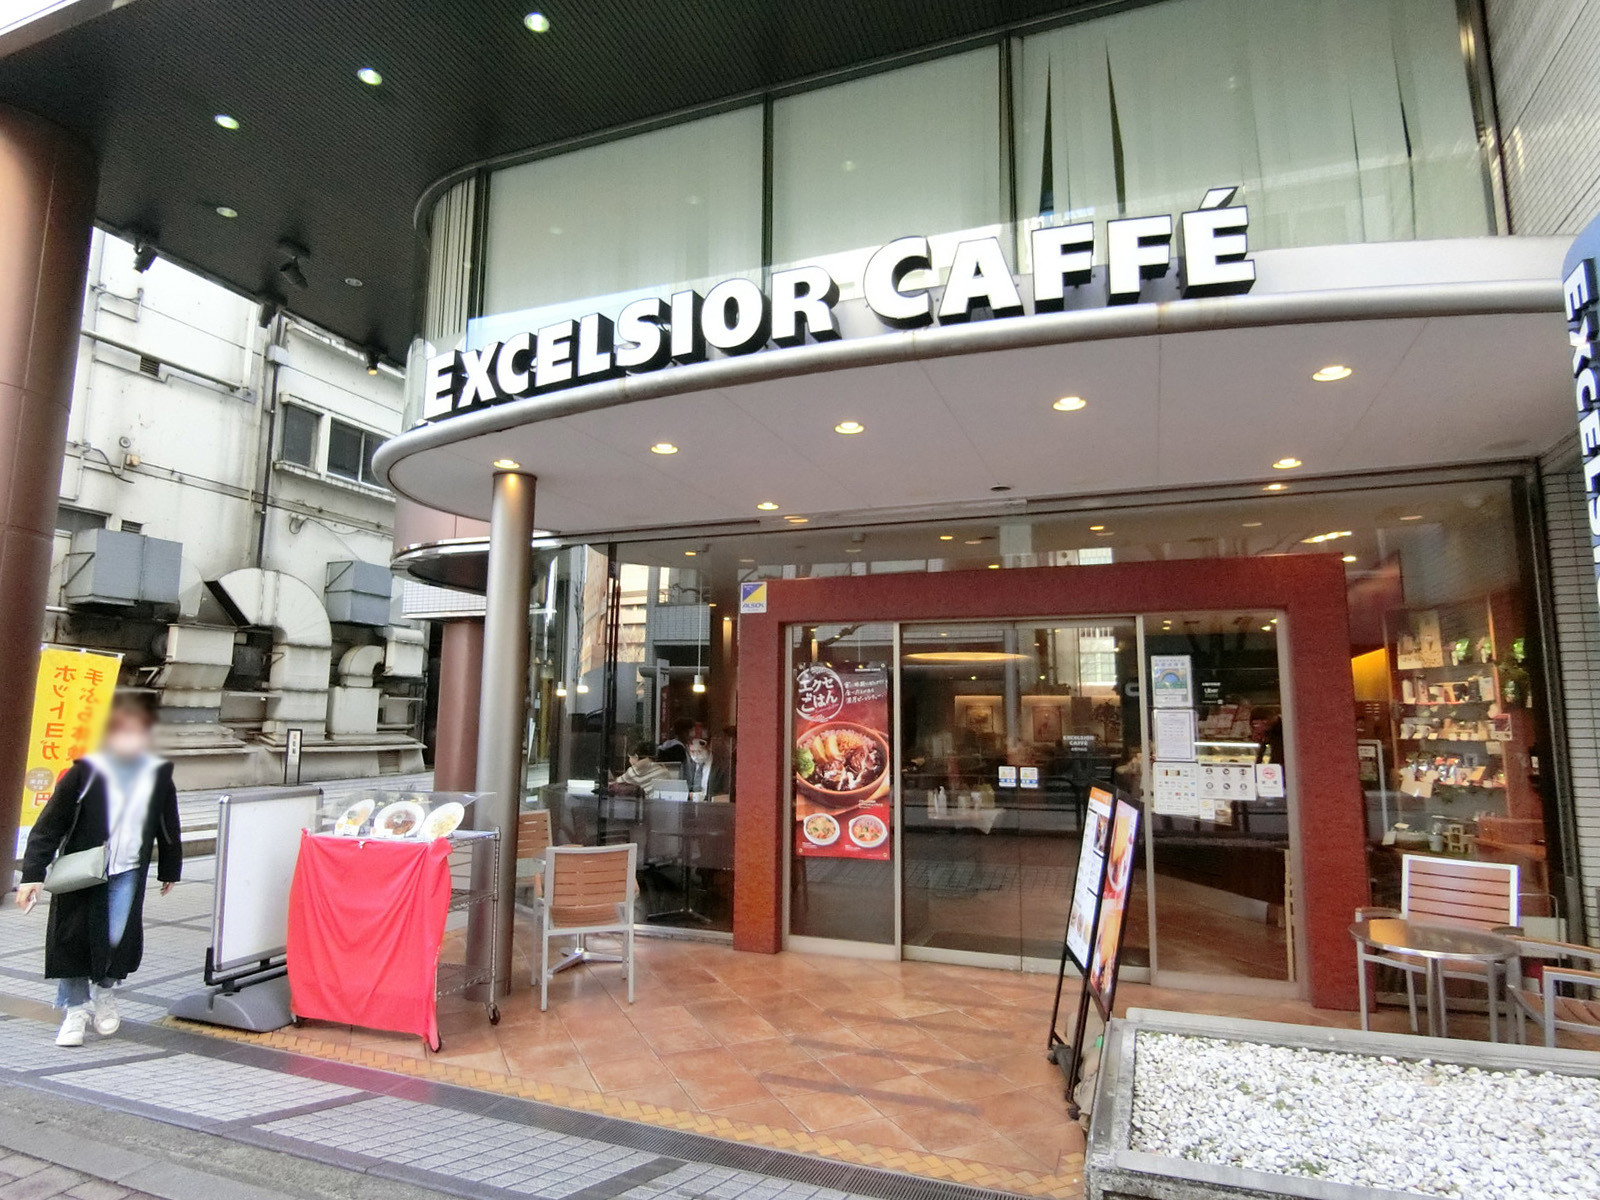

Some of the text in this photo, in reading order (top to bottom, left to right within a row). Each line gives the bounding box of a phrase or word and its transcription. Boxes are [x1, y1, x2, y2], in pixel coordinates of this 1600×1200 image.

[422, 186, 1255, 421] EXCELSIOR CAFFÉ
[798, 676, 834, 692] エクセ
[801, 690, 838, 712] ごはん
